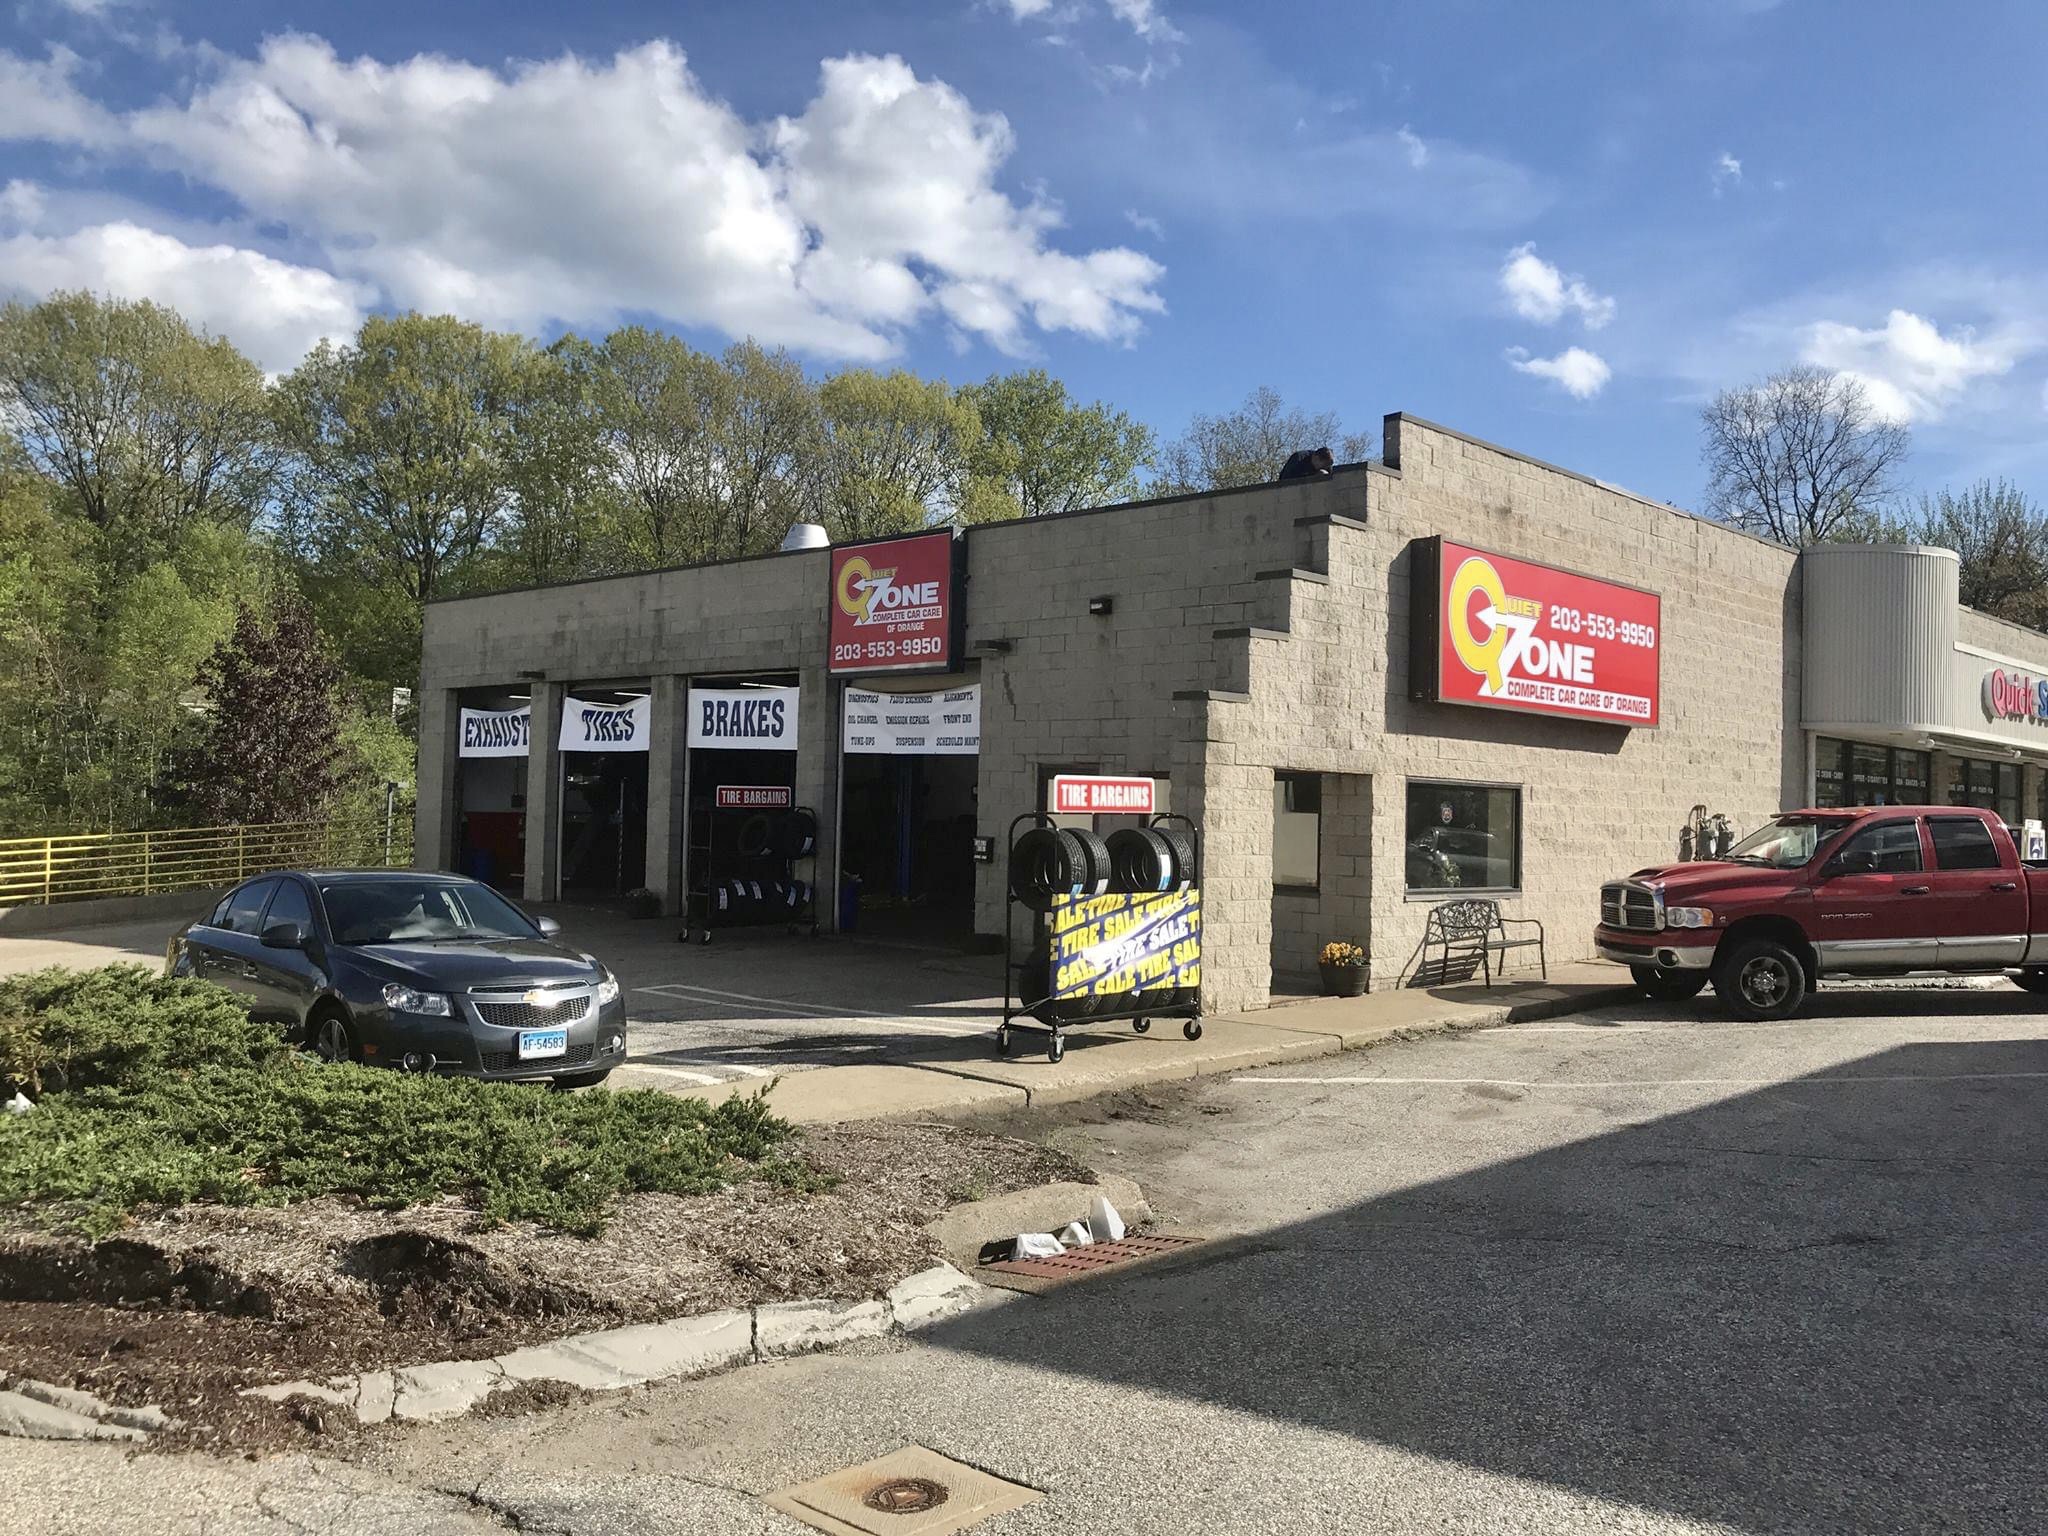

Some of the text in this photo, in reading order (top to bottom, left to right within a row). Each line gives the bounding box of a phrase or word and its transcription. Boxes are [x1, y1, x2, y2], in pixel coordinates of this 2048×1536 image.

[872, 608, 940, 623] COMPLETE CAR CARE
[887, 622, 924, 633] OF ORANGE
[1550, 605, 1655, 649] 203-553-9950
[835, 637, 941, 661] 203-553-9950
[1507, 680, 1648, 715] COMPLETE CAR CARE OF ORANGE
[1992, 668, 2033, 719] Quick
[464, 714, 531, 748] EXHAUST
[582, 709, 635, 742] TIRES
[702, 699, 784, 738] BRAKES
[943, 714, 972, 724] FRONT END
[896, 737, 925, 746] SUSPENSION
[722, 786, 787, 804] TIRE BARGAINS
[1060, 784, 1149, 807] TIRE BARGAINS
[1061, 922, 1100, 958] TIRE
[1148, 914, 1188, 950] SALE
[1136, 948, 1172, 983] TIRE
